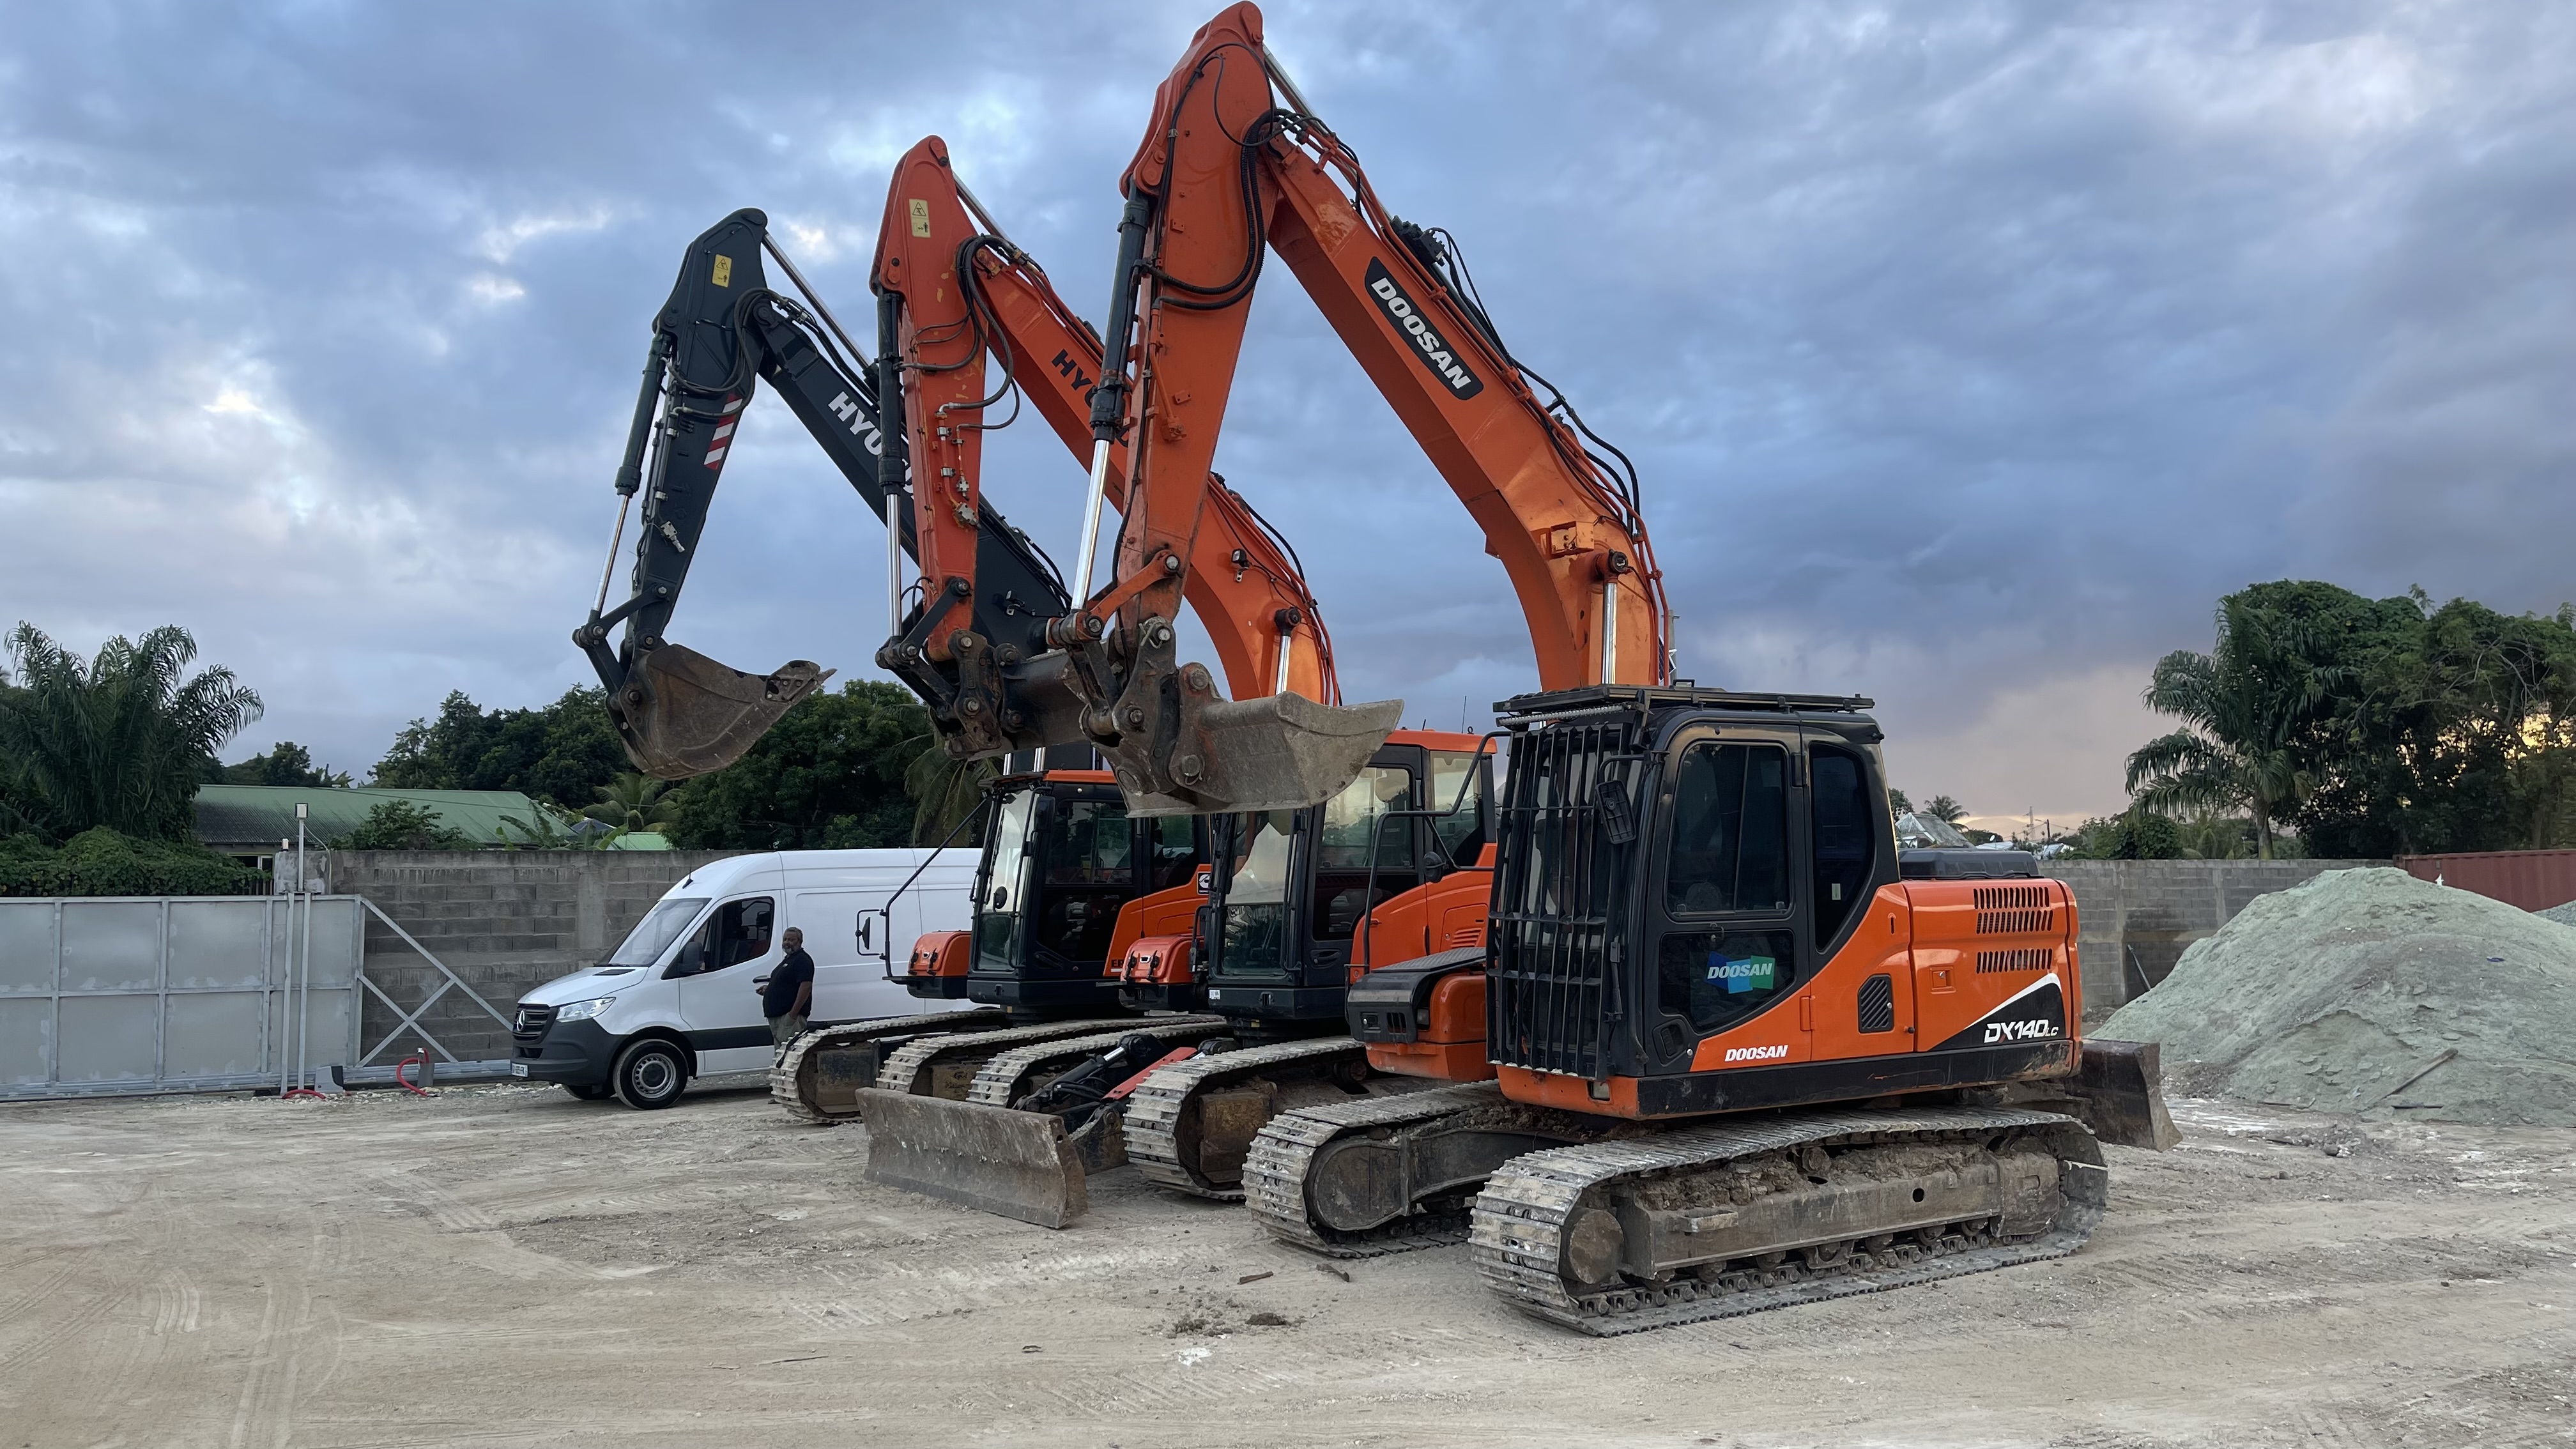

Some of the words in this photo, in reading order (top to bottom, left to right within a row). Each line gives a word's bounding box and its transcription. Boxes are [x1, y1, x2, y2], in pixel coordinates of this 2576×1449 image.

[1371, 277, 1471, 389] DOOSAN
[828, 391, 882, 456] HYU
[1707, 963, 1772, 979] DOOSAN
[1724, 1045, 1788, 1062] DOOSAN
